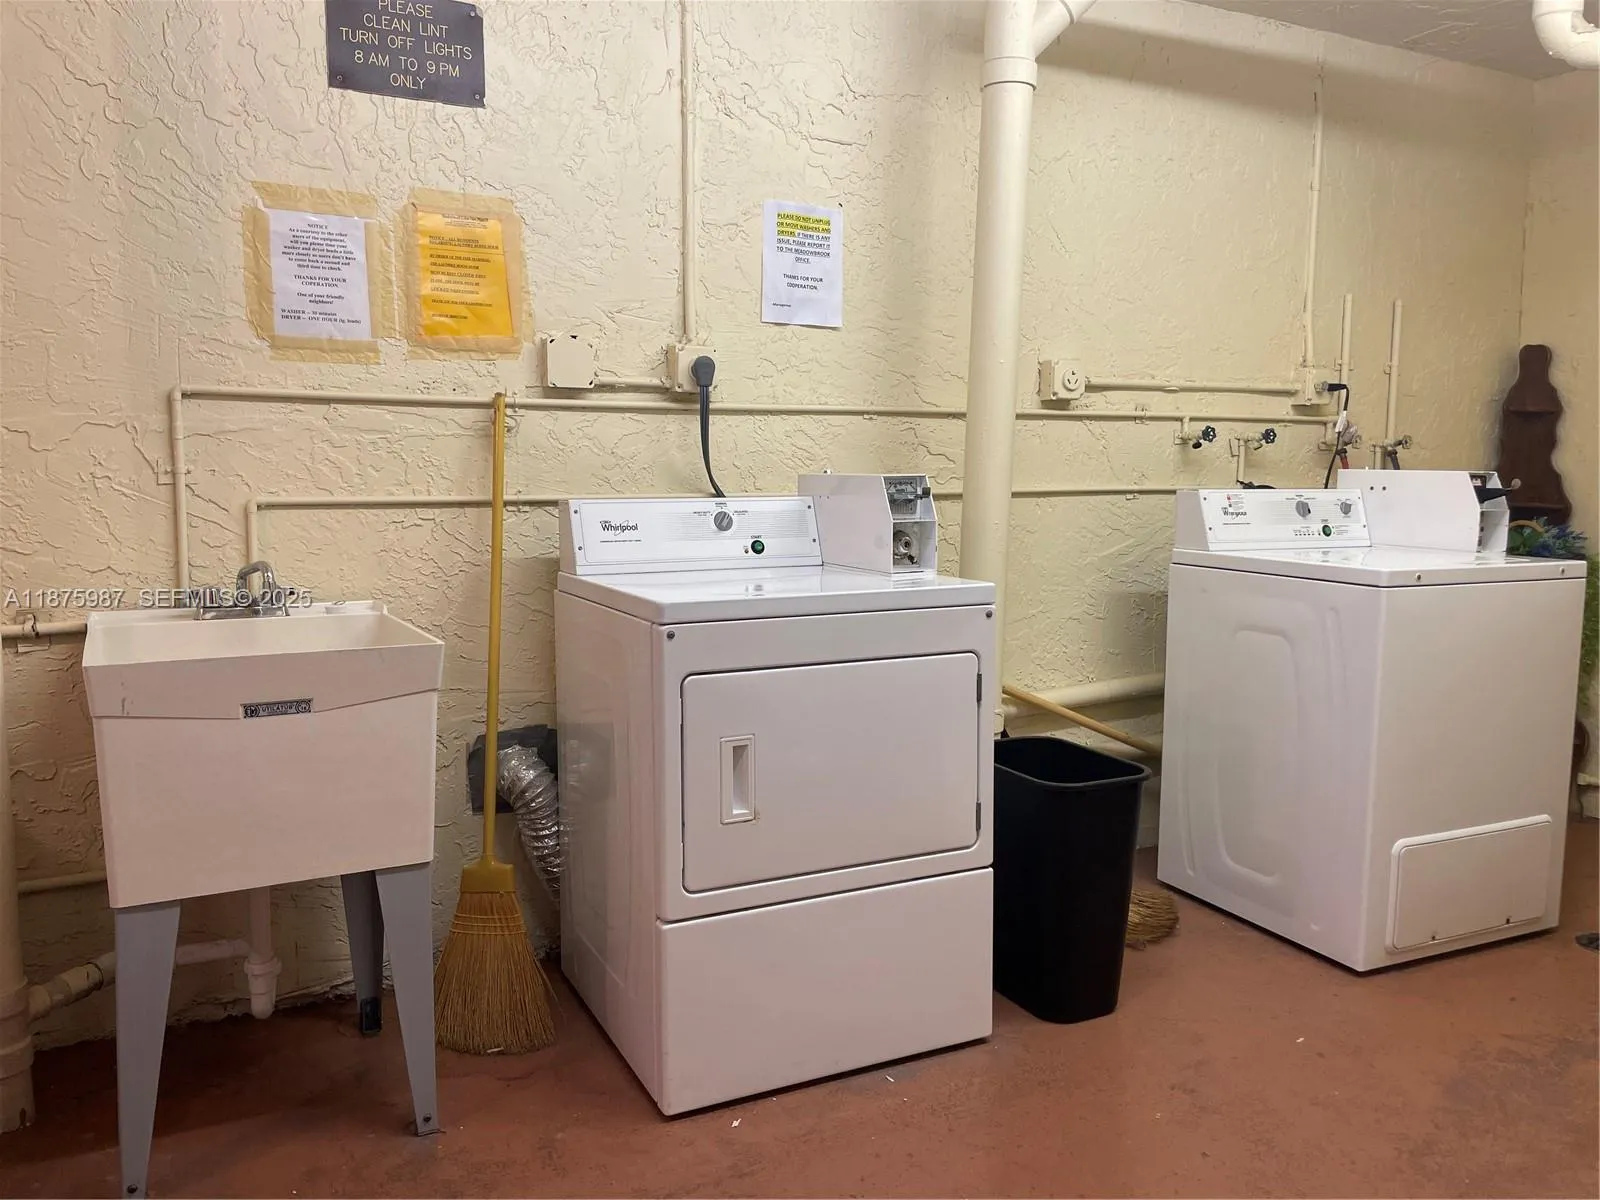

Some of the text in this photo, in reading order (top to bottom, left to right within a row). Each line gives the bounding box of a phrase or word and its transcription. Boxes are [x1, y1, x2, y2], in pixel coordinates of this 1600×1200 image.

[378, 0, 433, 19] PLEASE
[363, 13, 448, 38] CLEAN LINT
[339, 27, 472, 60] TURN OFF LIGHTS
[354, 50, 460, 77] 8 AM TO 9 PM
[390, 72, 426, 90] ONLY
[800, 224, 820, 232] WASHERS
[812, 218, 830, 226] UNPLUG
[601, 523, 638, 533] Whirlpool
